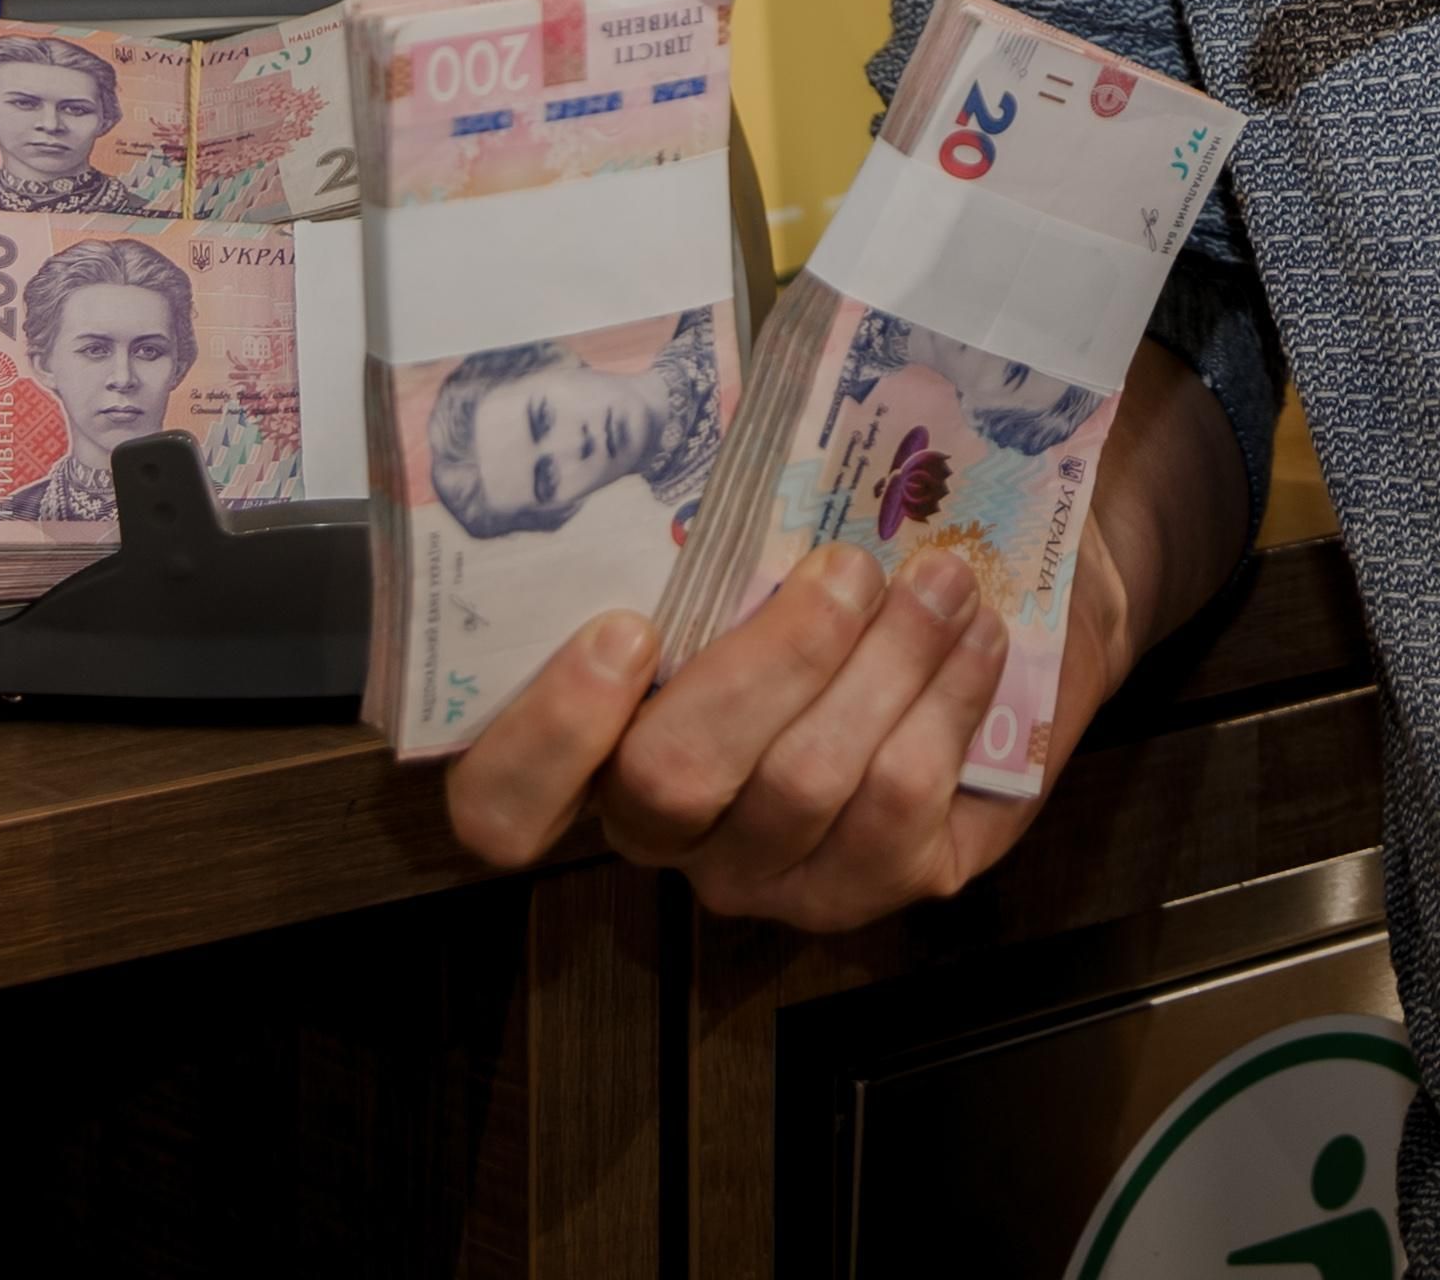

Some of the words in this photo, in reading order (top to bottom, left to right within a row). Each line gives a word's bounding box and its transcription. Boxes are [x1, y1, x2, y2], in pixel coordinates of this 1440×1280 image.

[601, 6, 705, 39] ГРИВЕНЬ
[142, 46, 250, 67] УКРЇНА
[426, 32, 531, 103] 200
[614, 33, 694, 65] ДВІСТІ
[1173, 135, 1223, 229] НАЦІОНАЛЬНИЙ
[1037, 484, 1076, 592] УКРАЇНА
